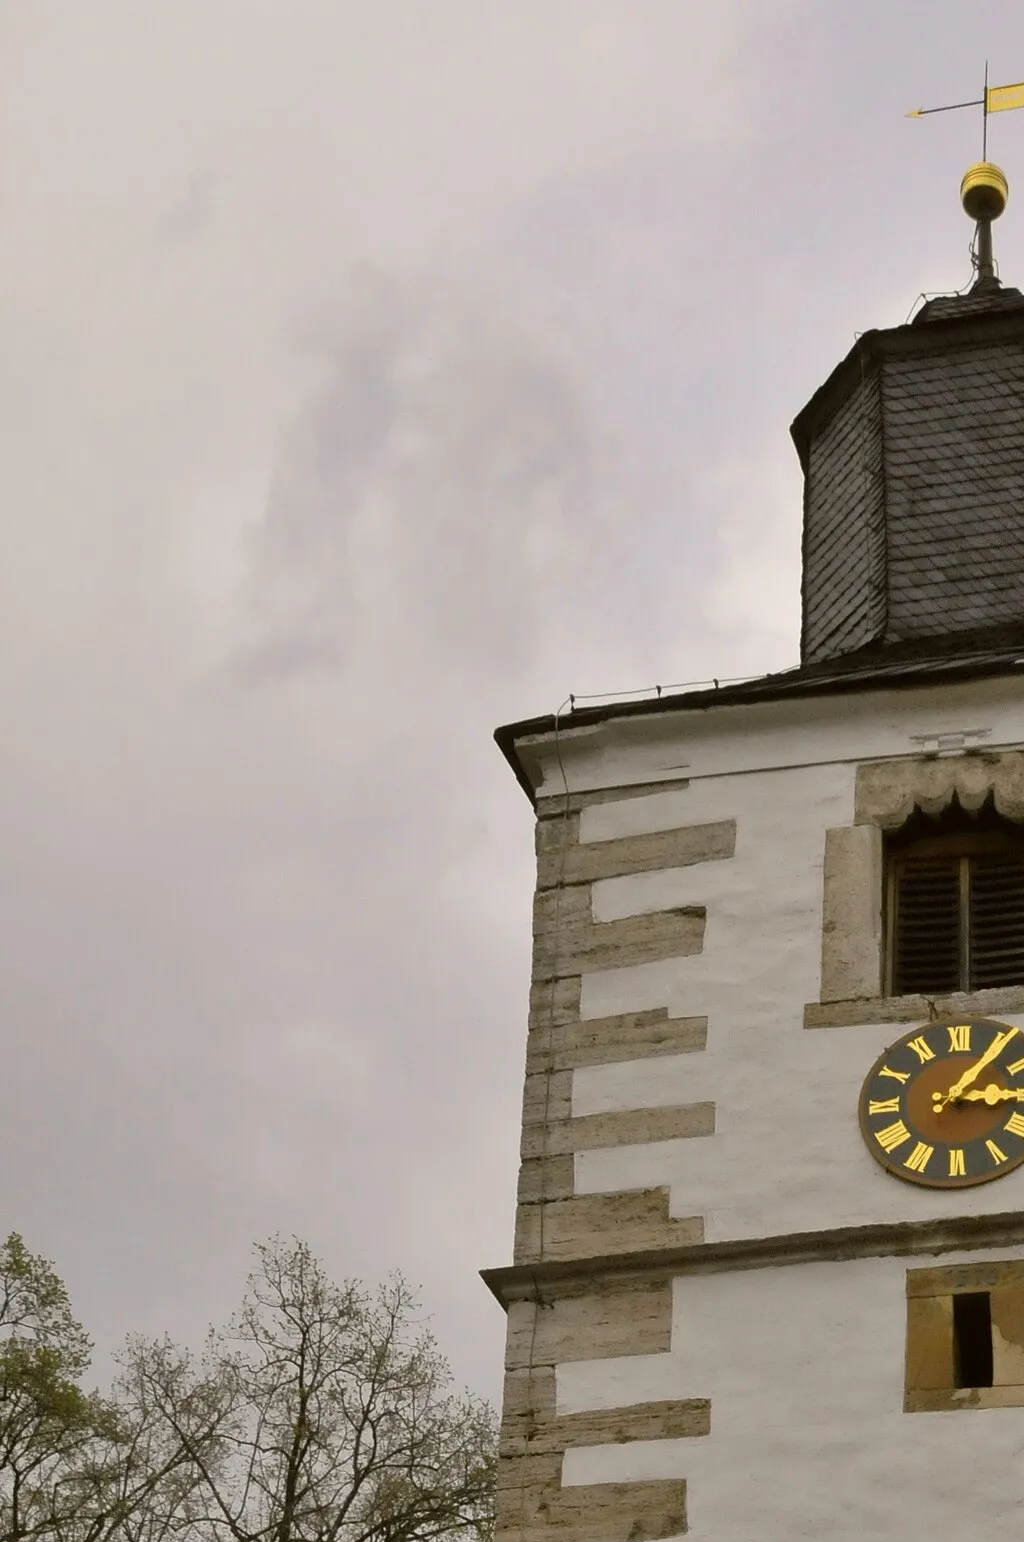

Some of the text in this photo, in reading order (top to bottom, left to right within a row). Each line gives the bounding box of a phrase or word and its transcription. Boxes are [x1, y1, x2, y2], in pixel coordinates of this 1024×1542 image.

[907, 1036, 936, 1064] XI
[947, 1025, 971, 1053] XII
[878, 1065, 911, 1084] X
[869, 1096, 900, 1115] IX
[874, 1119, 912, 1154] VIII
[903, 1141, 934, 1173] VII
[948, 1149, 966, 1177] VI
[985, 1139, 1008, 1165] V
